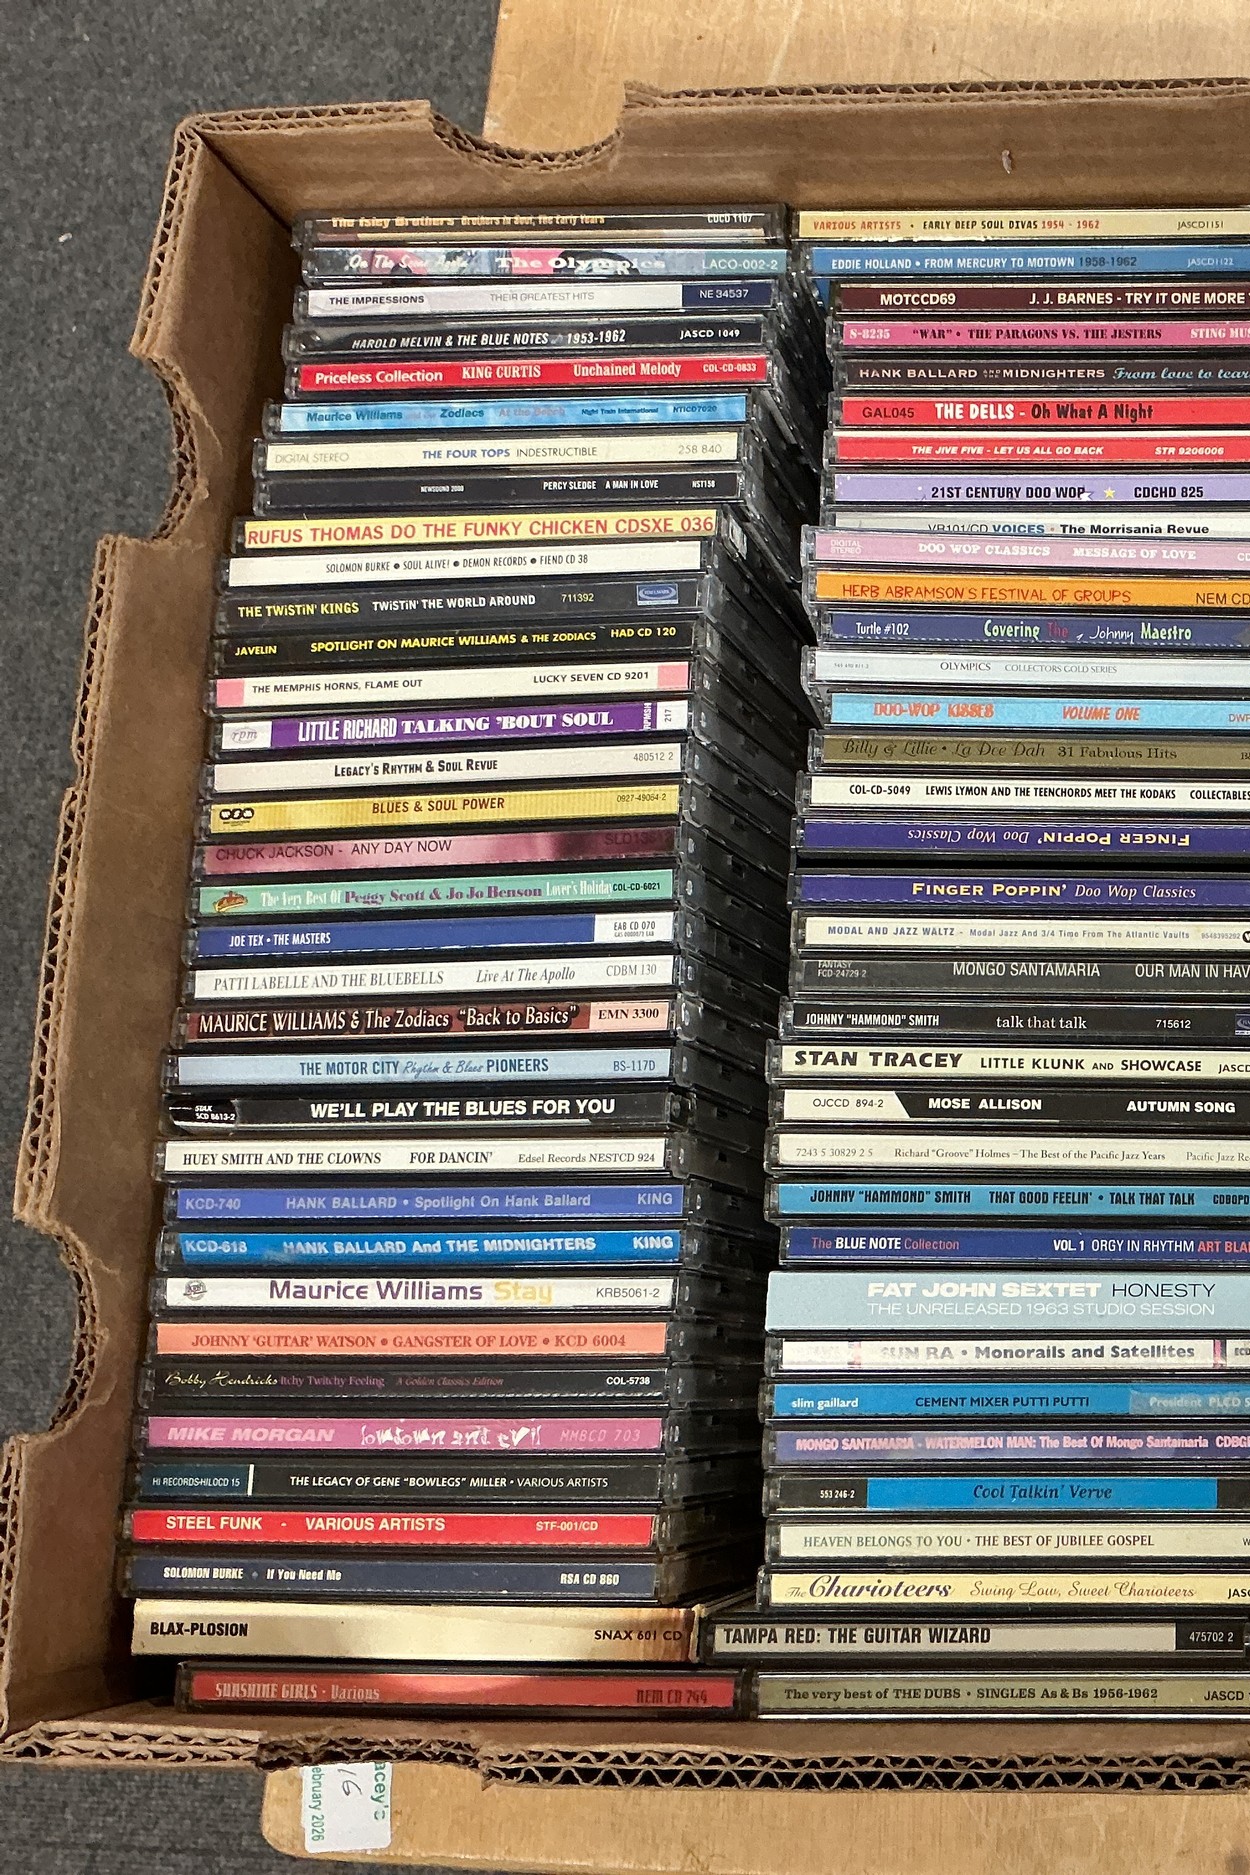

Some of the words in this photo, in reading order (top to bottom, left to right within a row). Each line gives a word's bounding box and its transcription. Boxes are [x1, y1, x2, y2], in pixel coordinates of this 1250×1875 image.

[329, 297, 349, 305] THE
[352, 296, 424, 304] IMPRESSIONS
[880, 294, 956, 306] MOTCCD69
[680, 329, 714, 339] JASCD
[718, 329, 739, 337] 1049
[316, 371, 373, 384] Priceless
[376, 368, 443, 383] Collection
[574, 363, 636, 377] Unchained
[640, 362, 682, 377] Melody
[422, 450, 442, 459] THE
[446, 449, 477, 458] FOUR
[481, 448, 510, 457] TOPS
[517, 447, 596, 457] INDESTRUCTIBLE
[1134, 487, 1176, 499] CDCHD
[1181, 487, 1204, 498] 825
[248, 527, 302, 545] RUFUS
[310, 525, 383, 542] THOMAS
[390, 523, 416, 540] DO
[423, 521, 457, 539] THE
[464, 519, 522, 537] FUNKY
[529, 518, 608, 535] CHICKEN
[616, 516, 674, 534] CDSXE
[681, 516, 714, 532] 036
[856, 622, 883, 635] Turtle
[885, 623, 910, 635] #102
[235, 645, 277, 656] JAVELIN
[940, 661, 990, 671] OLYMPICS
[401, 717, 490, 733] TALKING
[496, 713, 556, 729] 'BOUT
[562, 712, 613, 728] SOUL
[908, 830, 960, 842] Classics
[967, 828, 995, 842] Wop
[1003, 832, 1029, 843] Doo
[1038, 832, 1110, 844] POPPIN'
[1120, 833, 1189, 846] FINGER
[912, 883, 987, 896] FINGER
[993, 883, 1066, 896] POPPIN'
[1075, 885, 1100, 896] Doo
[1109, 885, 1137, 900] Wop
[1143, 885, 1195, 898] Classics
[1156, 1020, 1191, 1028] 715612
[795, 1051, 857, 1066] STAN
[869, 1052, 962, 1067] TRACEY
[310, 1103, 365, 1118] WE'LL
[372, 1102, 418, 1117] PLAY
[423, 1101, 460, 1116] THE
[465, 1100, 526, 1115] BLUES
[532, 1099, 570, 1114] FOR
[576, 1099, 615, 1113] YOU
[270, 1278, 368, 1299] Maurice
[377, 1281, 482, 1301] Williams
[494, 1280, 553, 1304] Stay
[596, 1287, 659, 1297] KRB5061-2
[1112, 1283, 1215, 1297] HONESTY
[606, 1376, 650, 1385] COL-5738
[166, 1515, 215, 1529] STEEL
[220, 1516, 262, 1529] FUNK
[150, 1622, 248, 1636] BLAX-PLOSION
[594, 1630, 632, 1641] SNAX
[637, 1630, 658, 1641] 601
[662, 1630, 682, 1641] CD
[724, 1625, 777, 1643] TAMPA
[785, 1628, 820, 1643] RED:
[828, 1625, 857, 1643] THE
[863, 1627, 921, 1643] GUITAR
[928, 1627, 991, 1643] WIZARD
[312, 1814, 324, 1842] 2026
